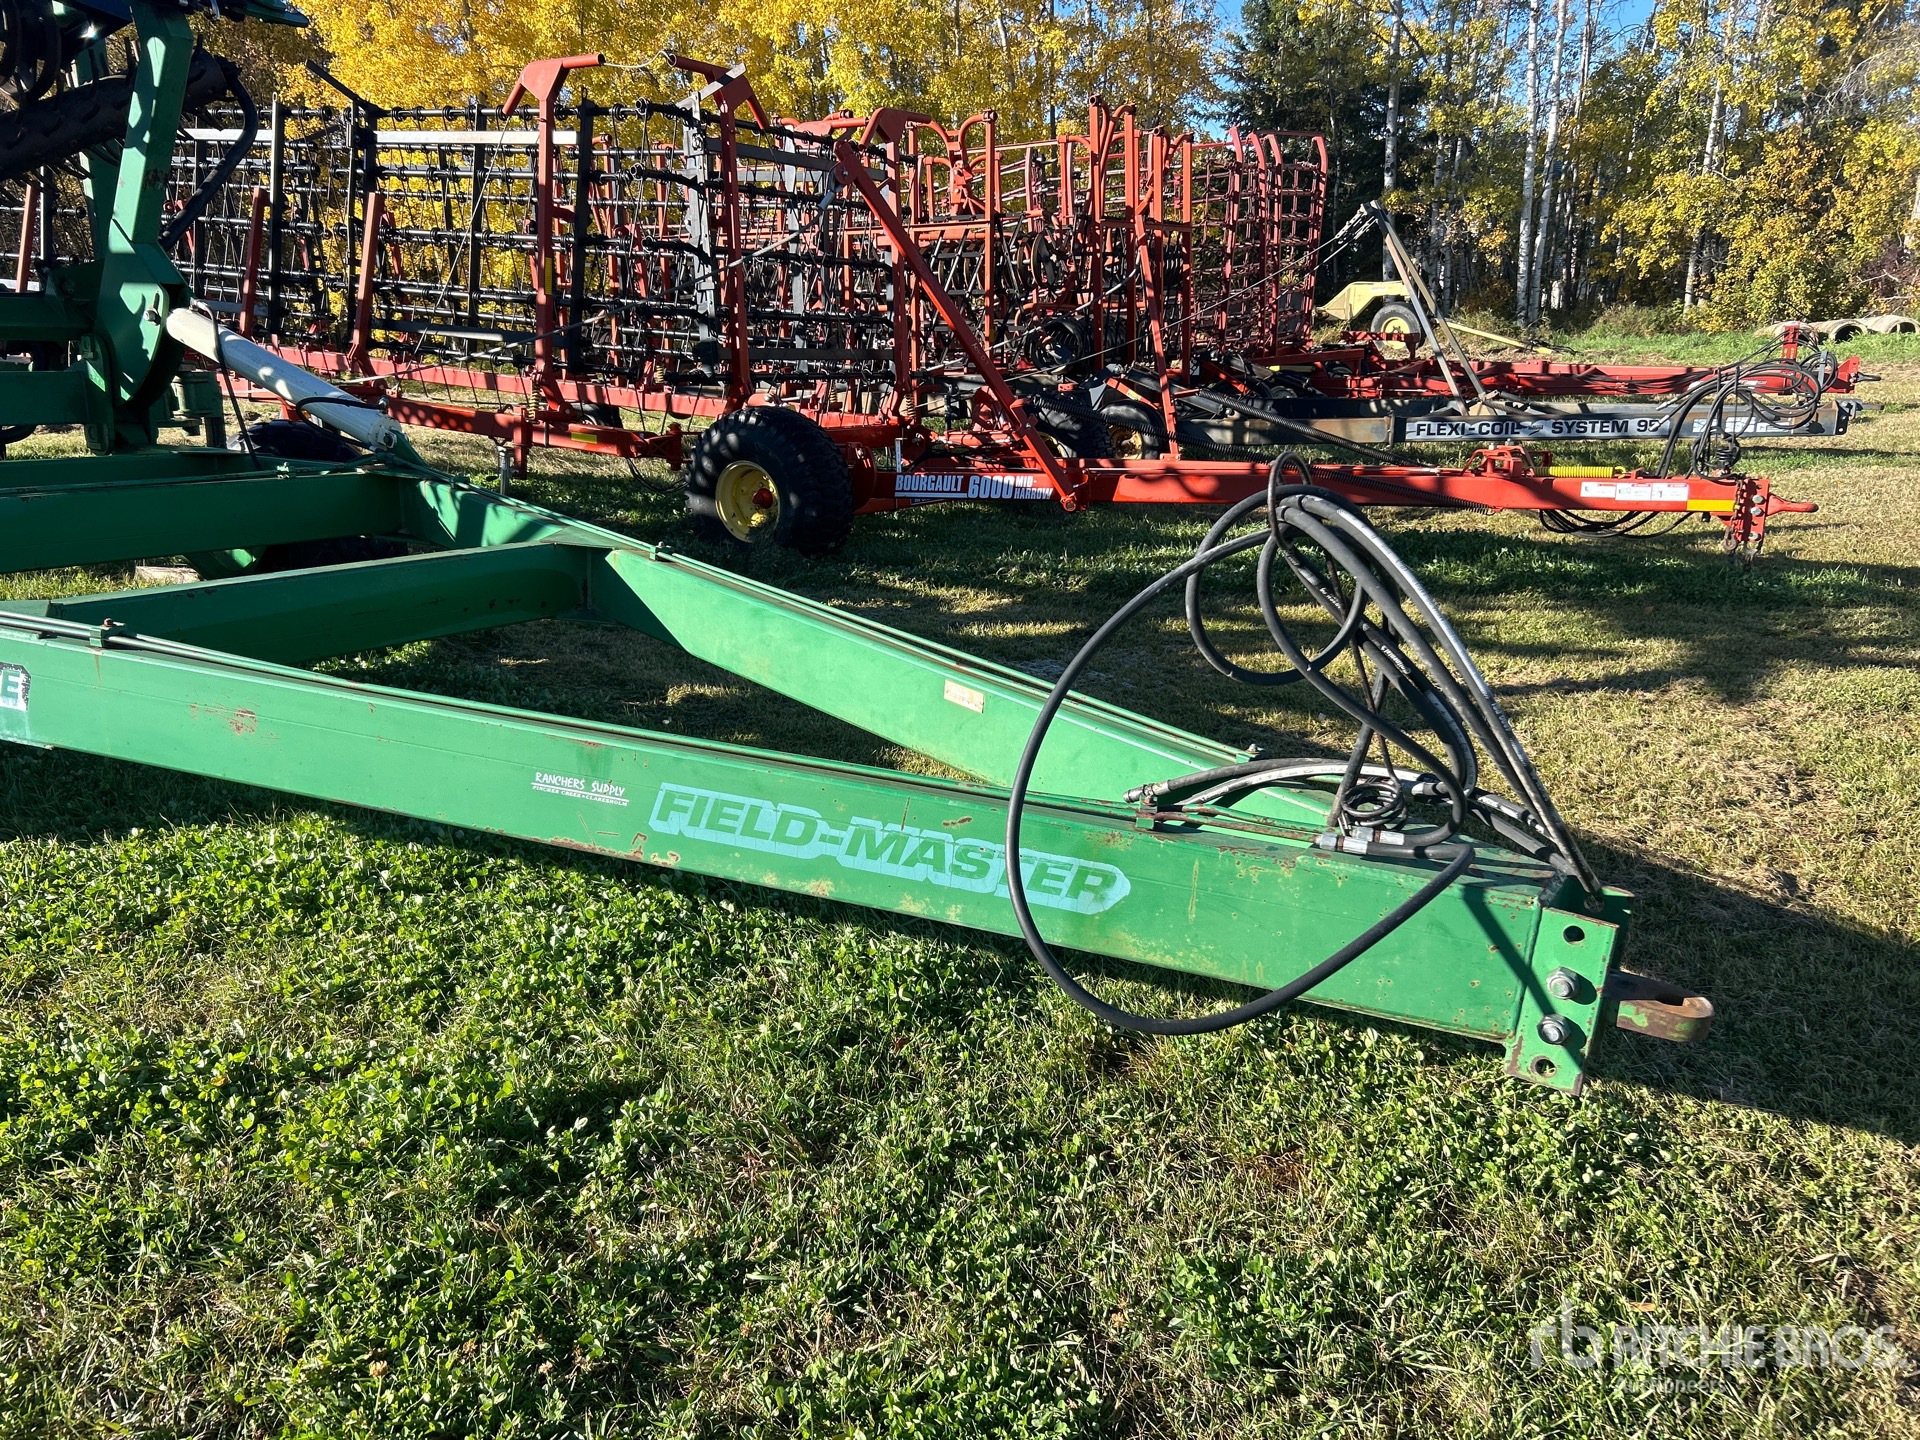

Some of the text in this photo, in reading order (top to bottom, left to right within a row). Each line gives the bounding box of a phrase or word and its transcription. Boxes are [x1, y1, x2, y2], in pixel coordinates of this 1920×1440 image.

[1416, 422, 1521, 437] FLEXI-COIL
[1551, 420, 1628, 434] SYSTEM
[895, 475, 1016, 499] BOURGAULT 6000
[1014, 488, 1053, 500] HARROW
[535, 771, 626, 797] RANCHERS SUPPLY
[657, 789, 1118, 904] FIELD-MASTER
